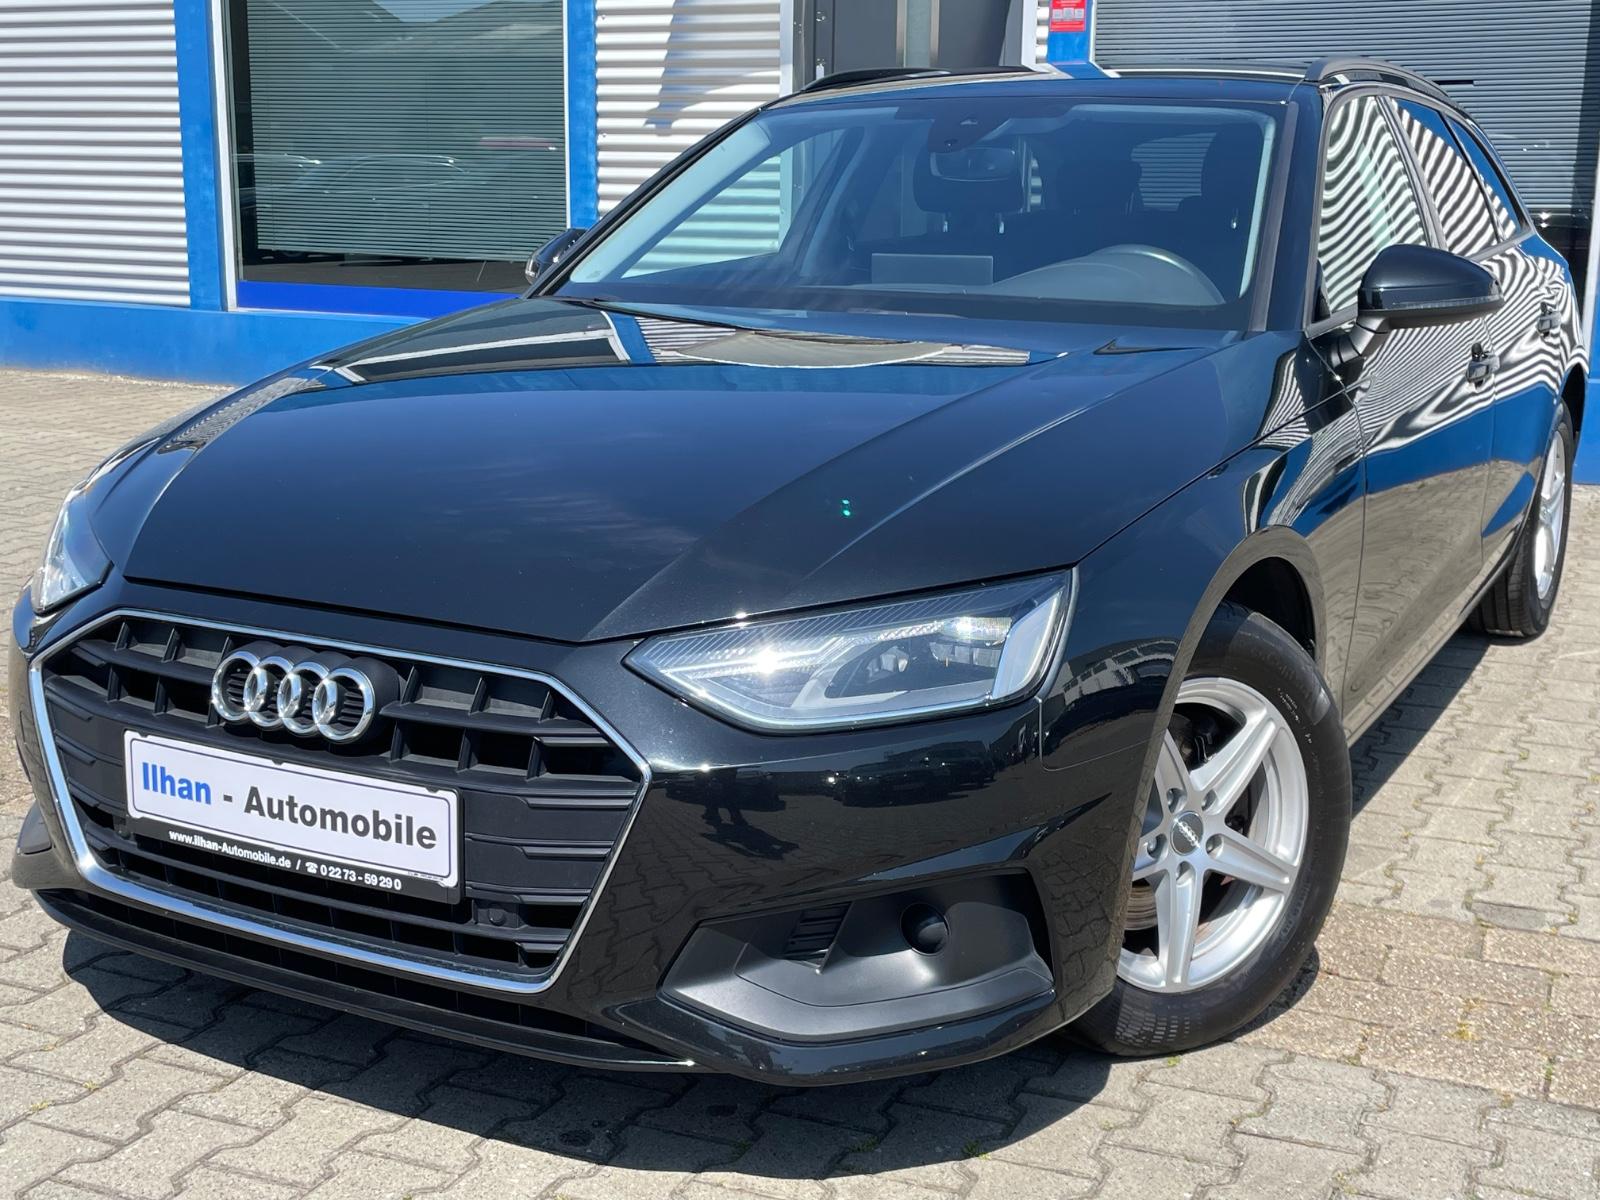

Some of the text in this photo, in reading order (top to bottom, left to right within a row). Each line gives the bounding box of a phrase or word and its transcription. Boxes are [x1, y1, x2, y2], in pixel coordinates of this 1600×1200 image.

[142, 762, 437, 849] Ilhan - Automobile
